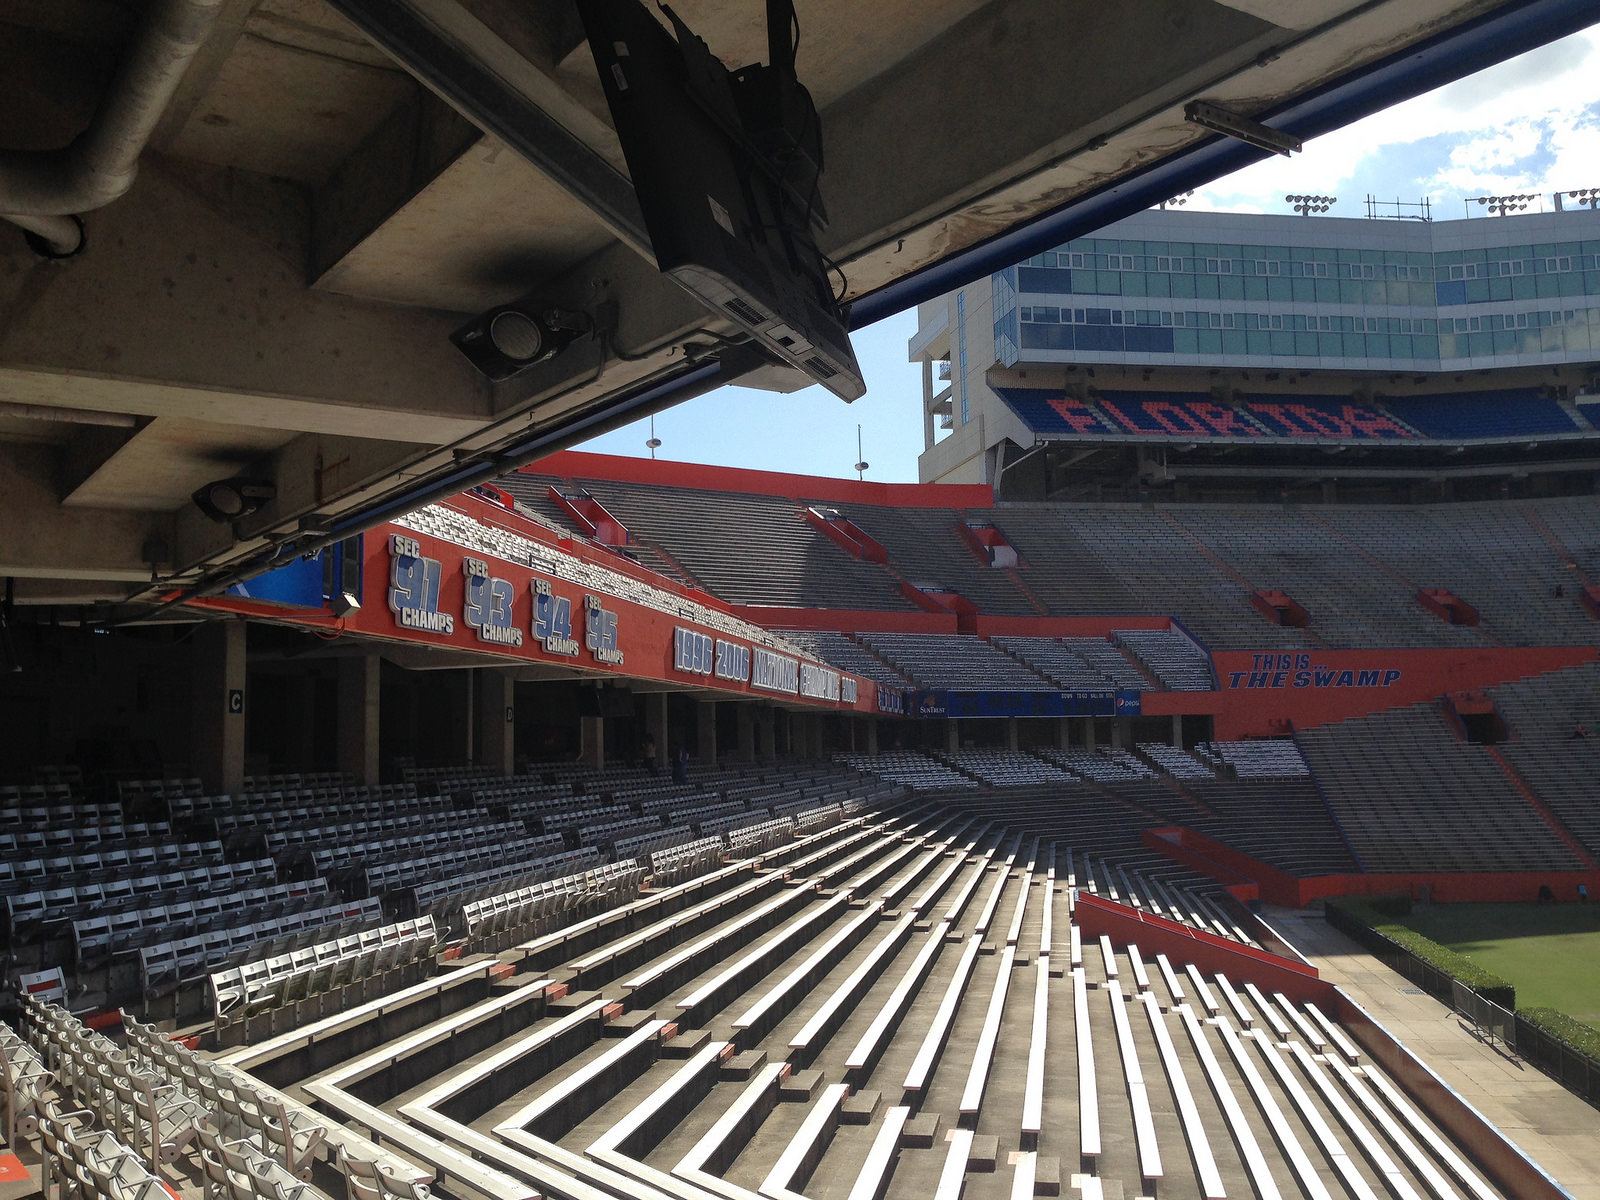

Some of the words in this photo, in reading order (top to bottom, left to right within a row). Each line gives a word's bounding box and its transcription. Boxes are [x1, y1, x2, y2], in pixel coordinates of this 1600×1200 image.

[1047, 399, 1413, 438] FLORIDA
[395, 535, 420, 557] SEC
[468, 559, 489, 577] SEC
[390, 555, 442, 613] 91
[534, 579, 552, 595] SEC
[466, 576, 514, 628] 93
[587, 595, 602, 609] SEC
[402, 607, 454, 634] CHAMPS
[534, 594, 572, 640] 94
[482, 624, 523, 647] CHAMPS
[587, 608, 618, 651] 95
[546, 636, 580, 656] CHAMPS
[597, 647, 625, 665] CHAMPS
[674, 626, 713, 675] 1996
[715, 639, 750, 682] 2006
[752, 647, 799, 694] NATIONAL
[1252, 654, 1291, 671] THIS
[1228, 671, 1288, 689] THE
[1293, 670, 1401, 688] SWAMP
[231, 693, 241, 710] C
